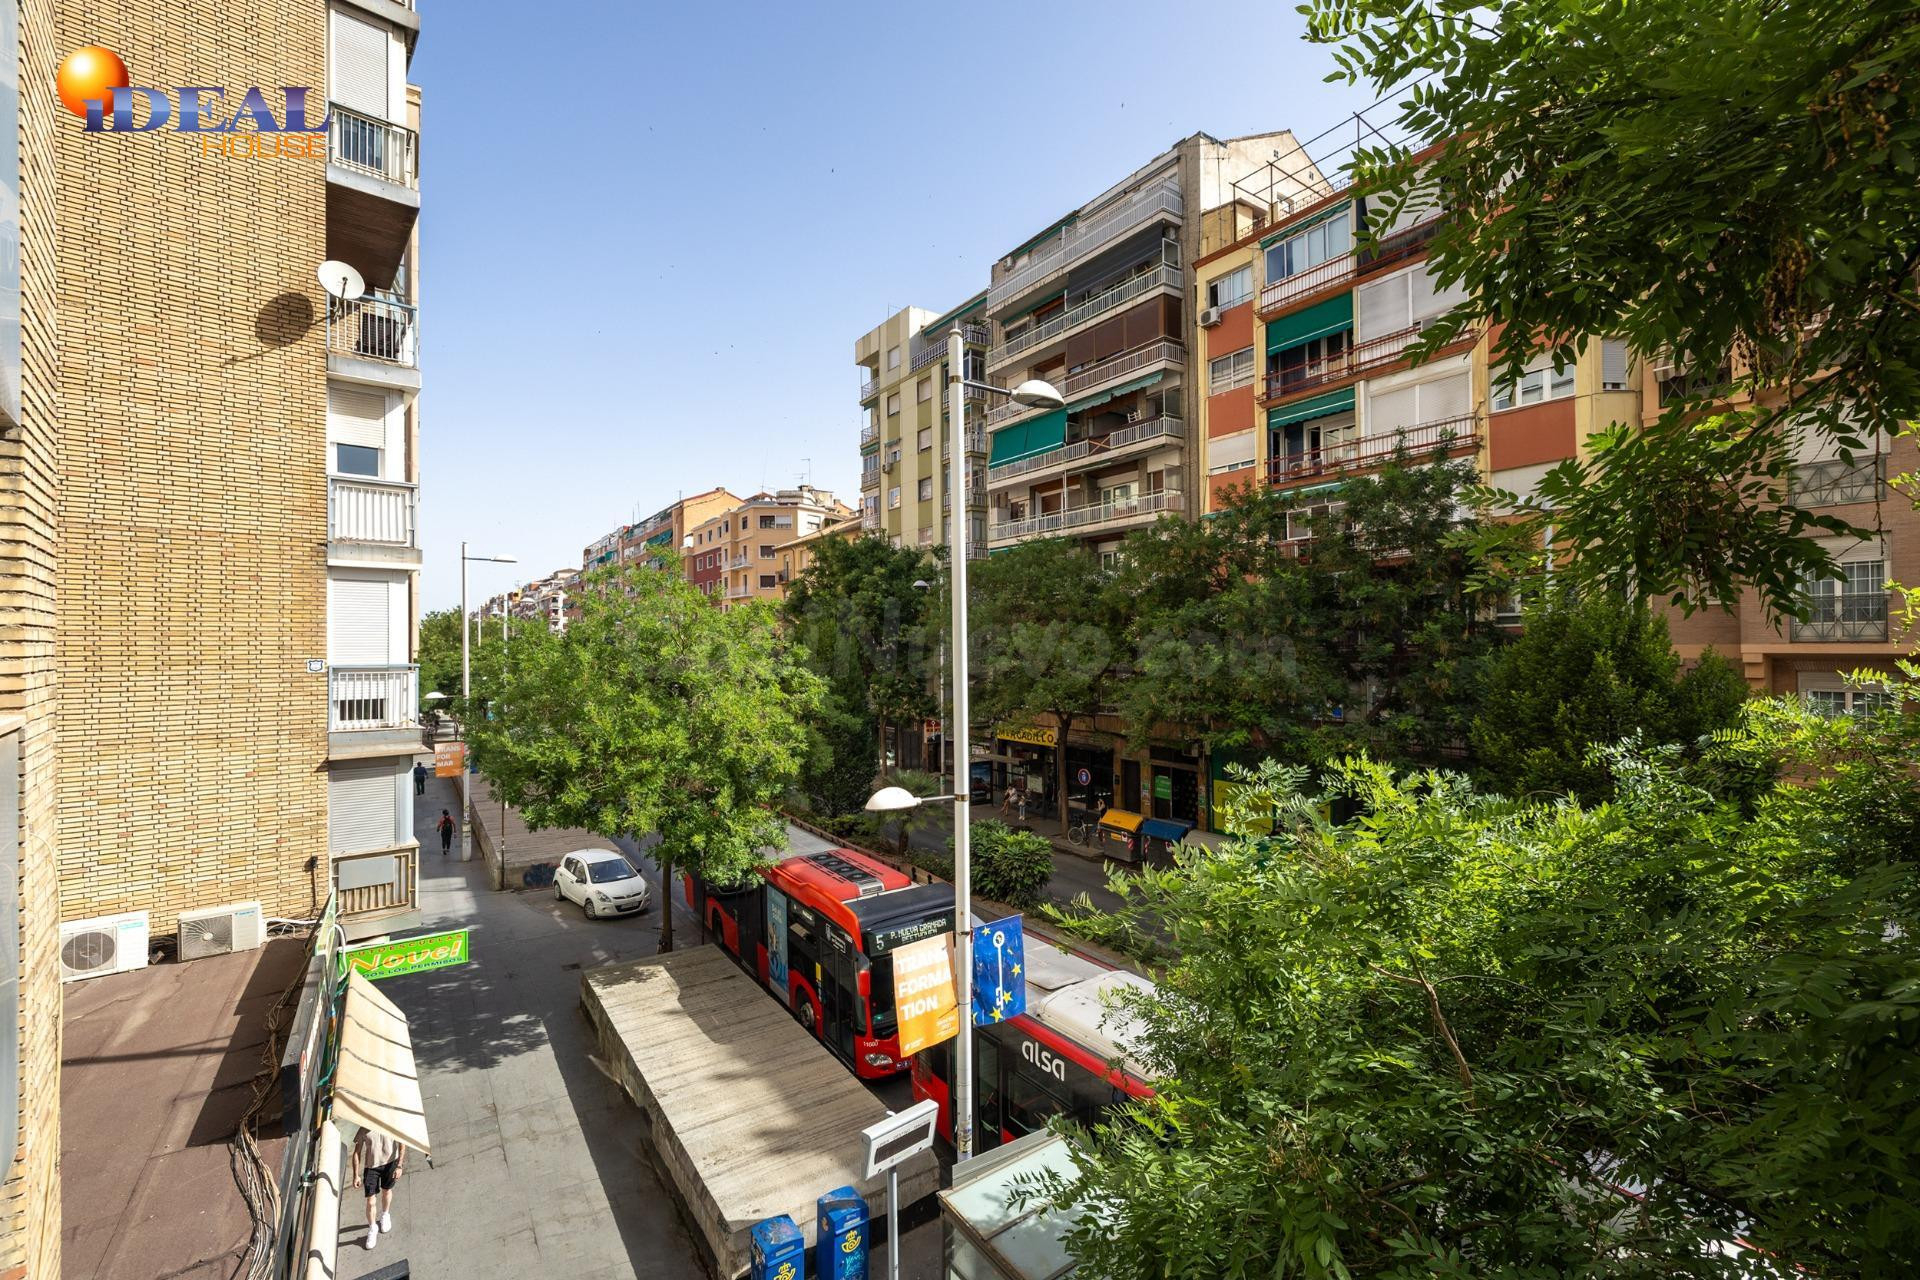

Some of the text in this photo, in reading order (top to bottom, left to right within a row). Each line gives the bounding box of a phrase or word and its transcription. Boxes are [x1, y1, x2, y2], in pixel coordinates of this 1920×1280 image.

[919, 919, 947, 932] GRANADA
[349, 934, 463, 957] AUTOESCUELAS
[876, 934, 885, 950] 5
[362, 956, 463, 979] DOS LOS PERMISOS
[901, 996, 938, 1020] TION
[1021, 1040, 1065, 1082] alsa
